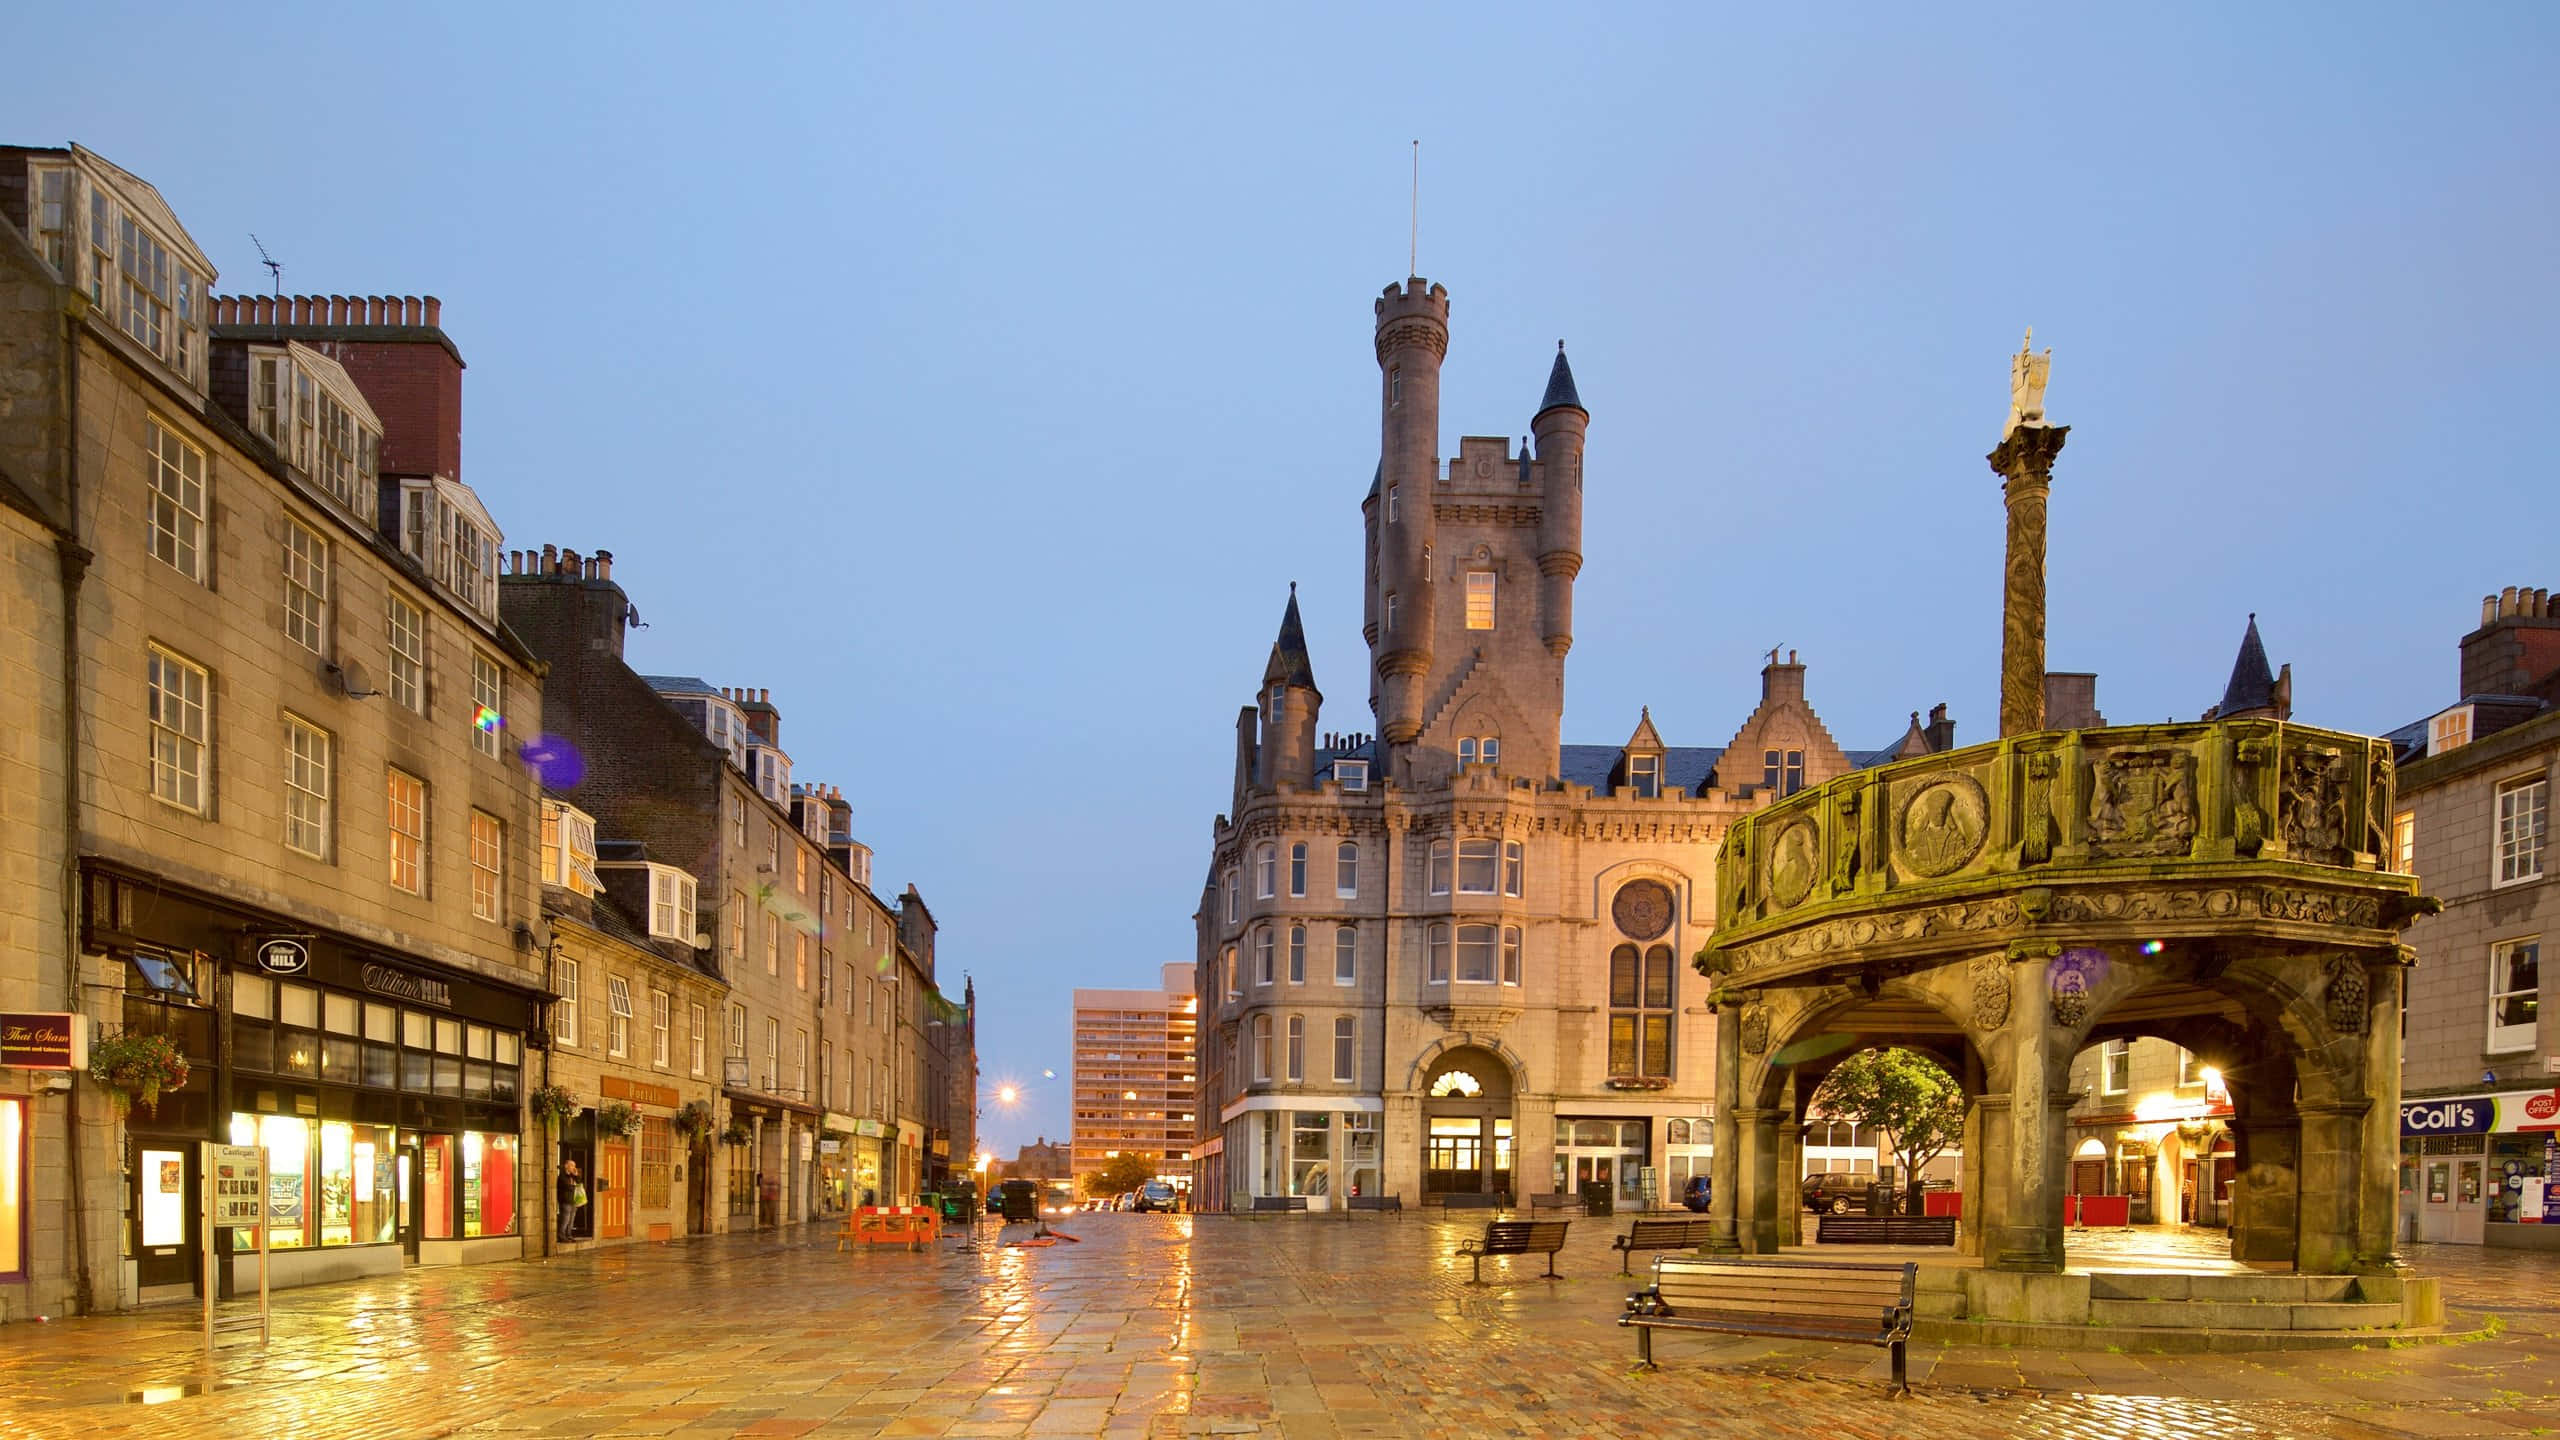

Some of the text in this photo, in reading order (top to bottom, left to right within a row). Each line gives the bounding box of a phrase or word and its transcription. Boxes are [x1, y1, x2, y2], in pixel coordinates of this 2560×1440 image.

[271, 955, 297, 966] HILL
[421, 978, 451, 1006] HILL
[3, 1026, 68, 1042] Thai Siam
[2401, 1104, 2474, 1129] cColl's
